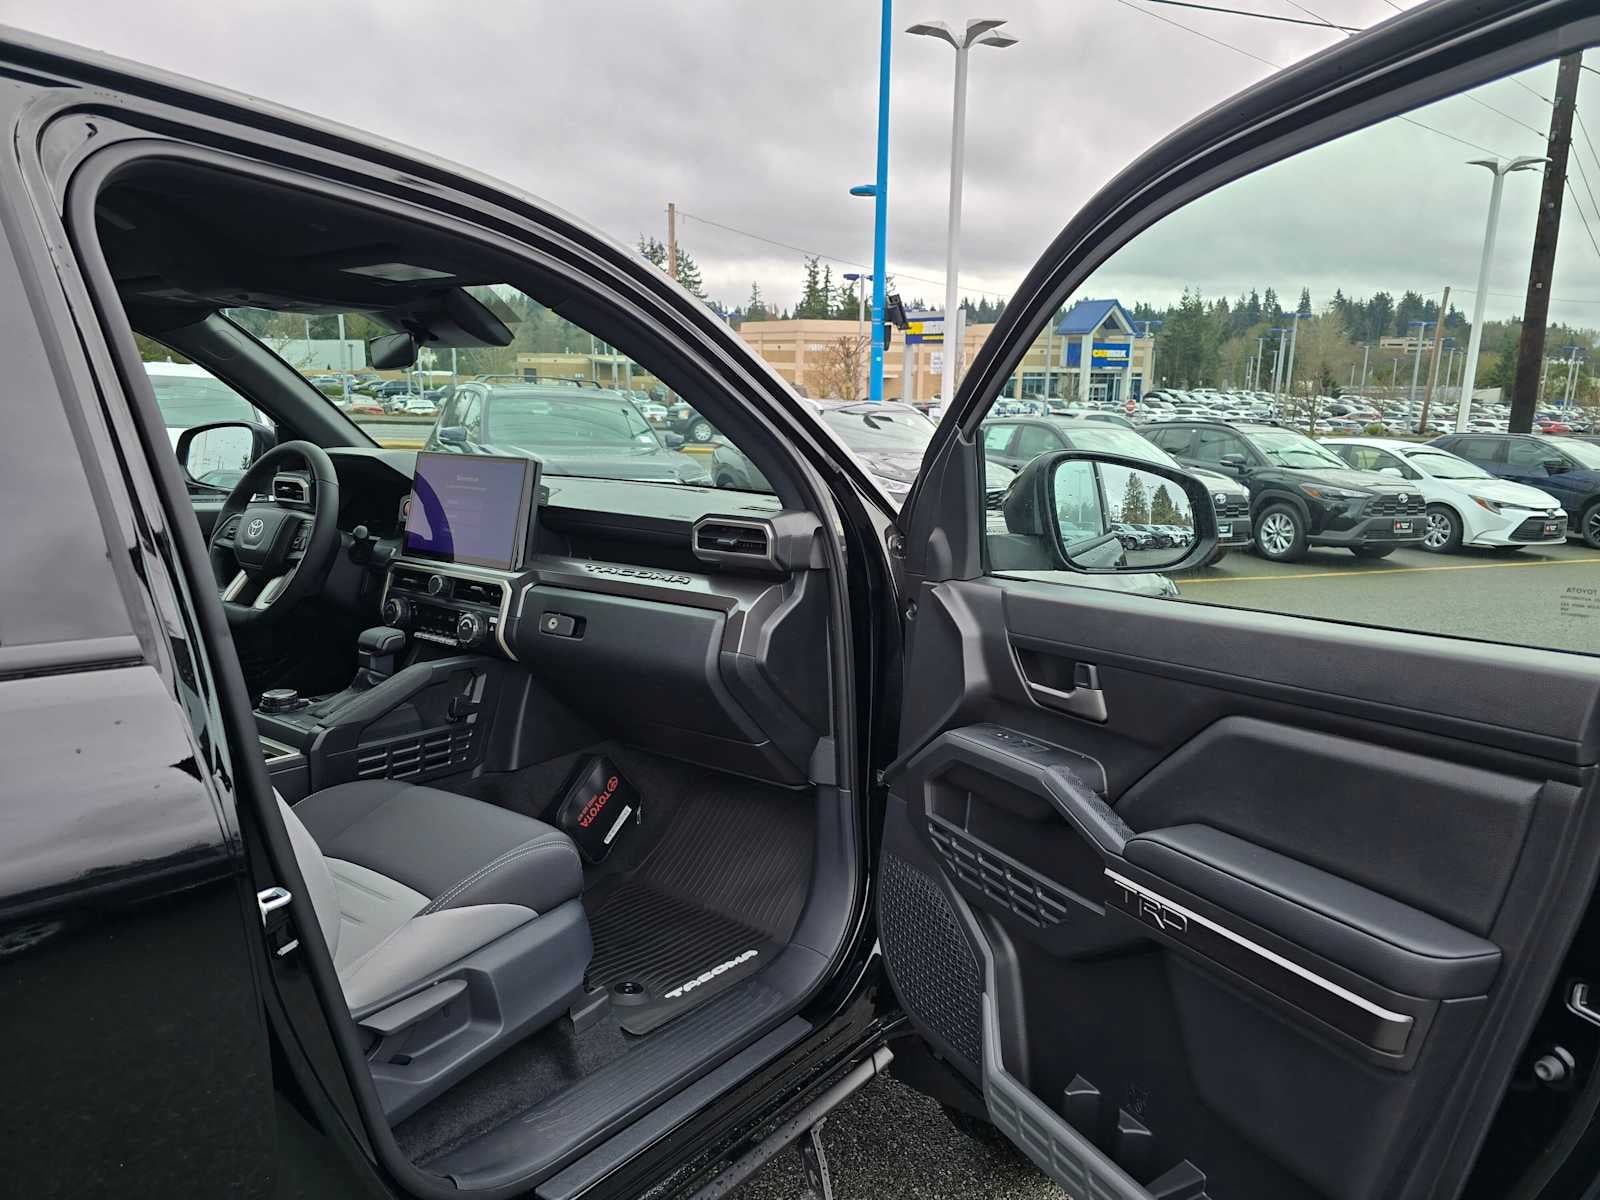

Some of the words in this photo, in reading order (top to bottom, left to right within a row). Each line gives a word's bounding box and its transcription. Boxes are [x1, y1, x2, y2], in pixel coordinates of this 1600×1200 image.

[585, 563, 691, 584] TACOMA
[579, 791, 611, 827] TOYOTA
[1114, 880, 1187, 933] TRD
[665, 950, 758, 998] TACOMA
